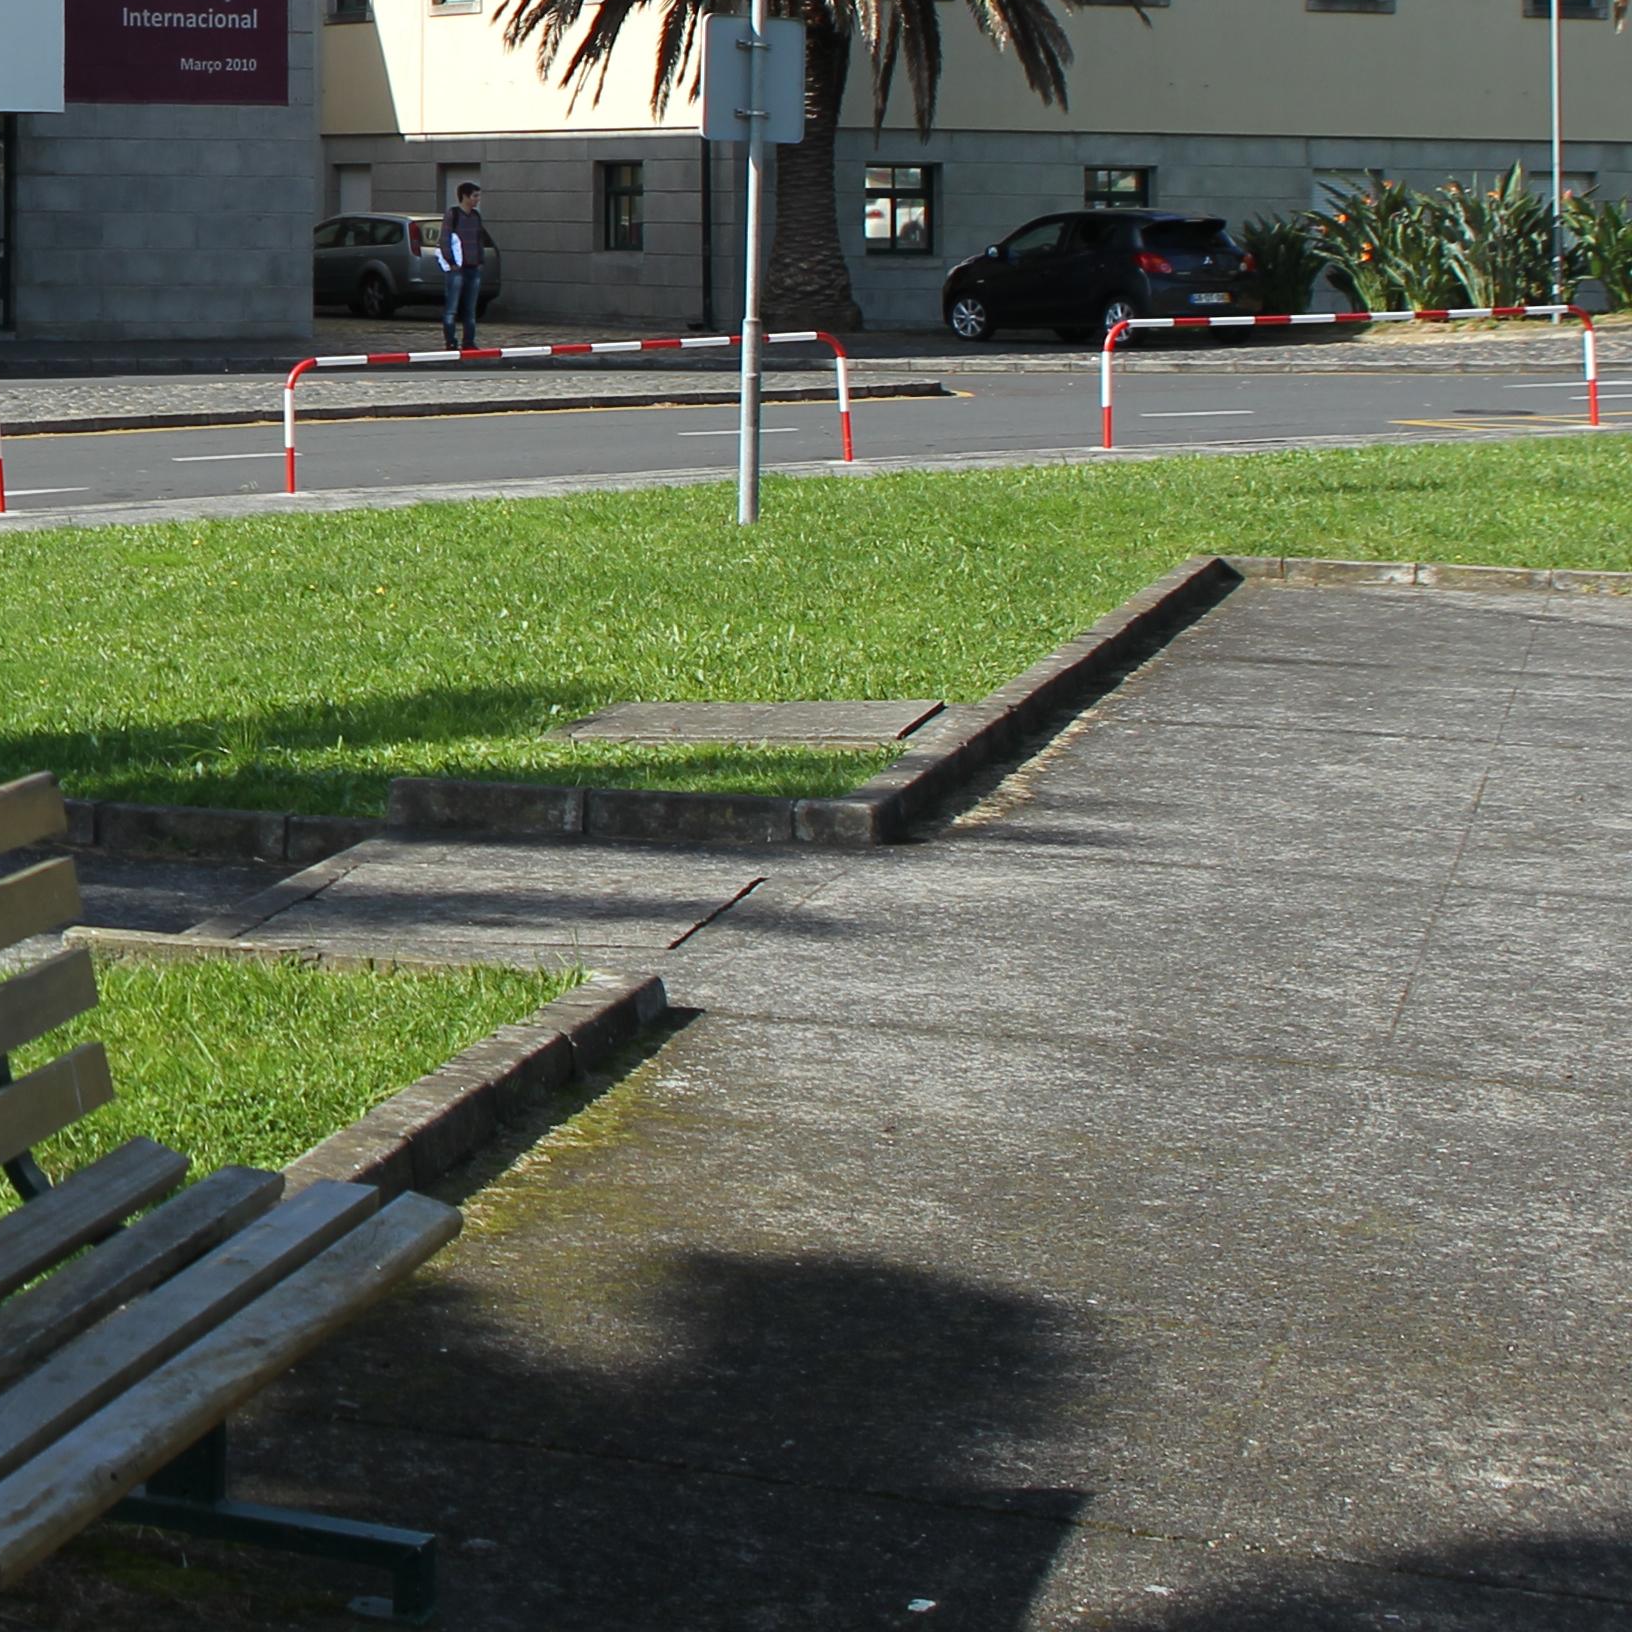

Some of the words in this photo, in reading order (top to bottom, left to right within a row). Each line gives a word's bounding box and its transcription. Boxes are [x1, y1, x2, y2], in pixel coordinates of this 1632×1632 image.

[122, 7, 258, 29] Internacional
[180, 58, 222, 74] Março
[225, 58, 257, 71] 2010
